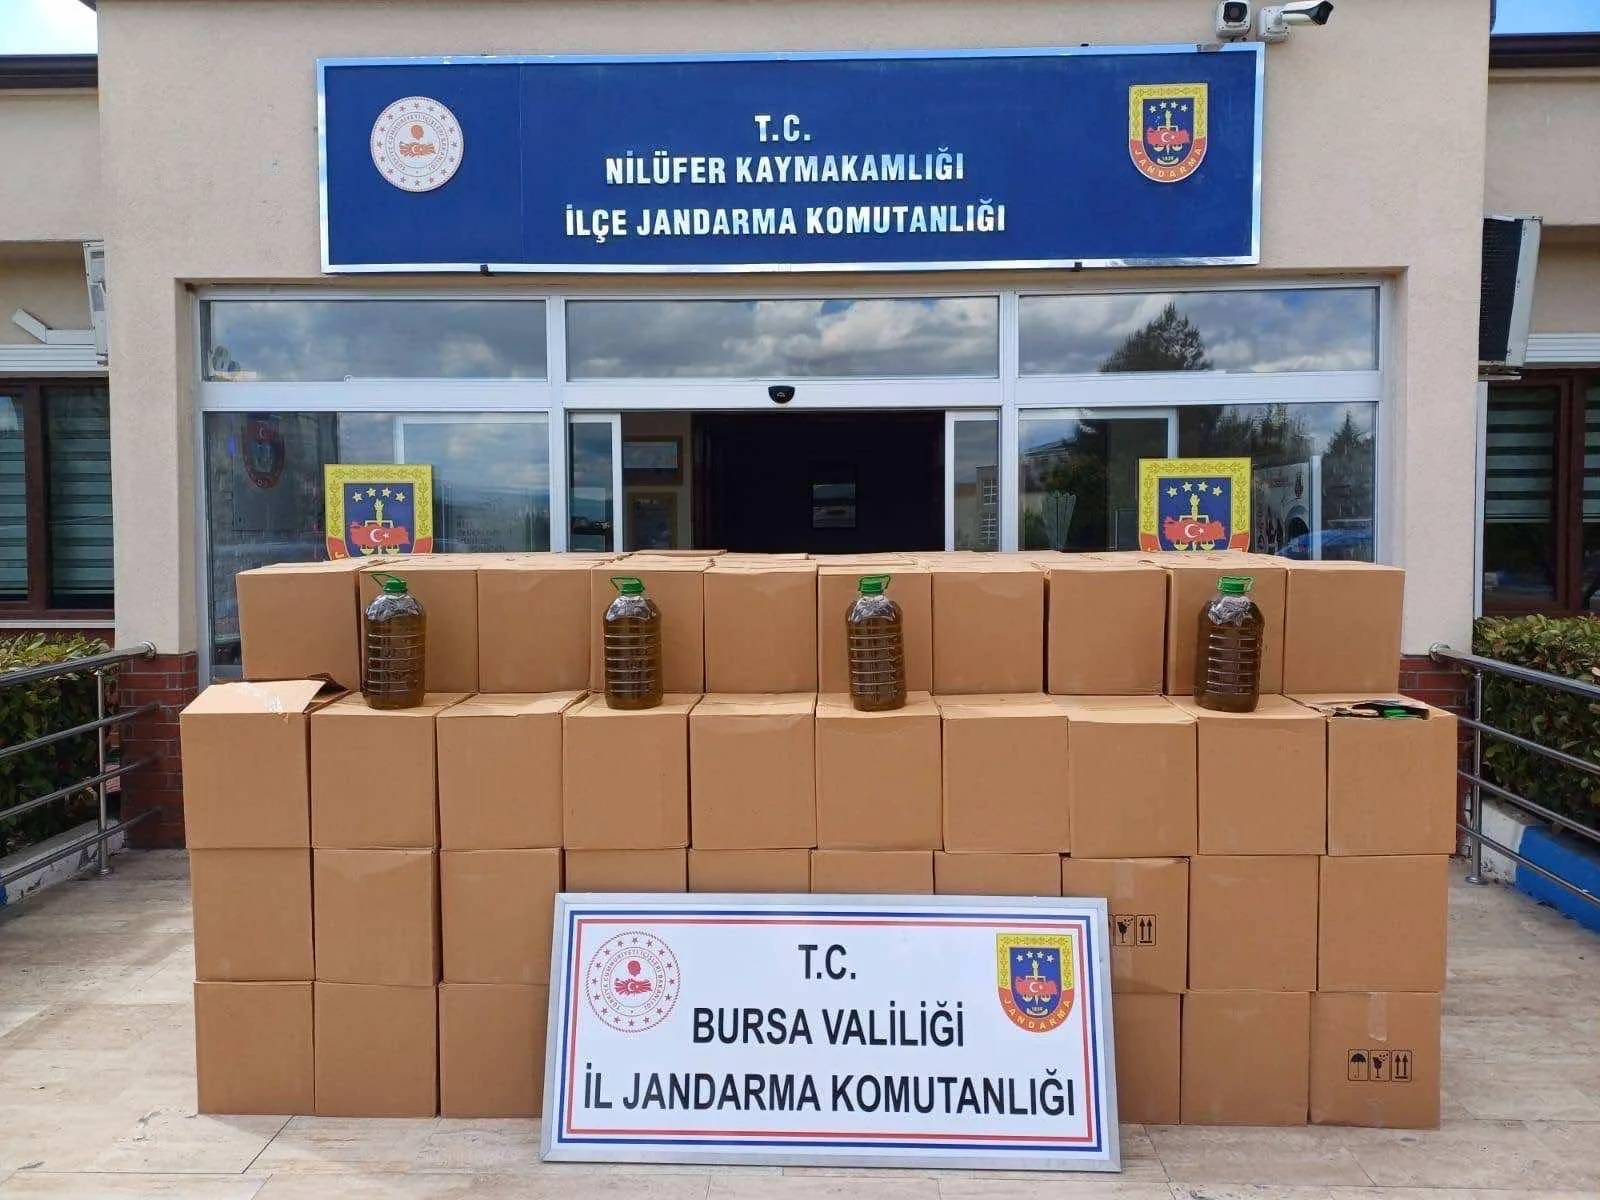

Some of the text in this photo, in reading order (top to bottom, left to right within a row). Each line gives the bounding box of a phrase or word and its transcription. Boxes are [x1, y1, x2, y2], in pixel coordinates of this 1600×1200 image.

[755, 114, 811, 142] T.C.
[605, 147, 964, 185] NİLÜFER KAYMAKAMLIĞI
[1134, 147, 1202, 178] JANDARMA
[565, 199, 1005, 244] İLÇE JANDARMA KOMUTANLIĞI
[799, 945, 856, 980] T.C.
[693, 1001, 964, 1047] BURSA VALİLİĞİ
[1003, 999, 1071, 1030] JANDARMA
[584, 1063, 1075, 1116] İL JANDARMA KOMUTANLIĞI
